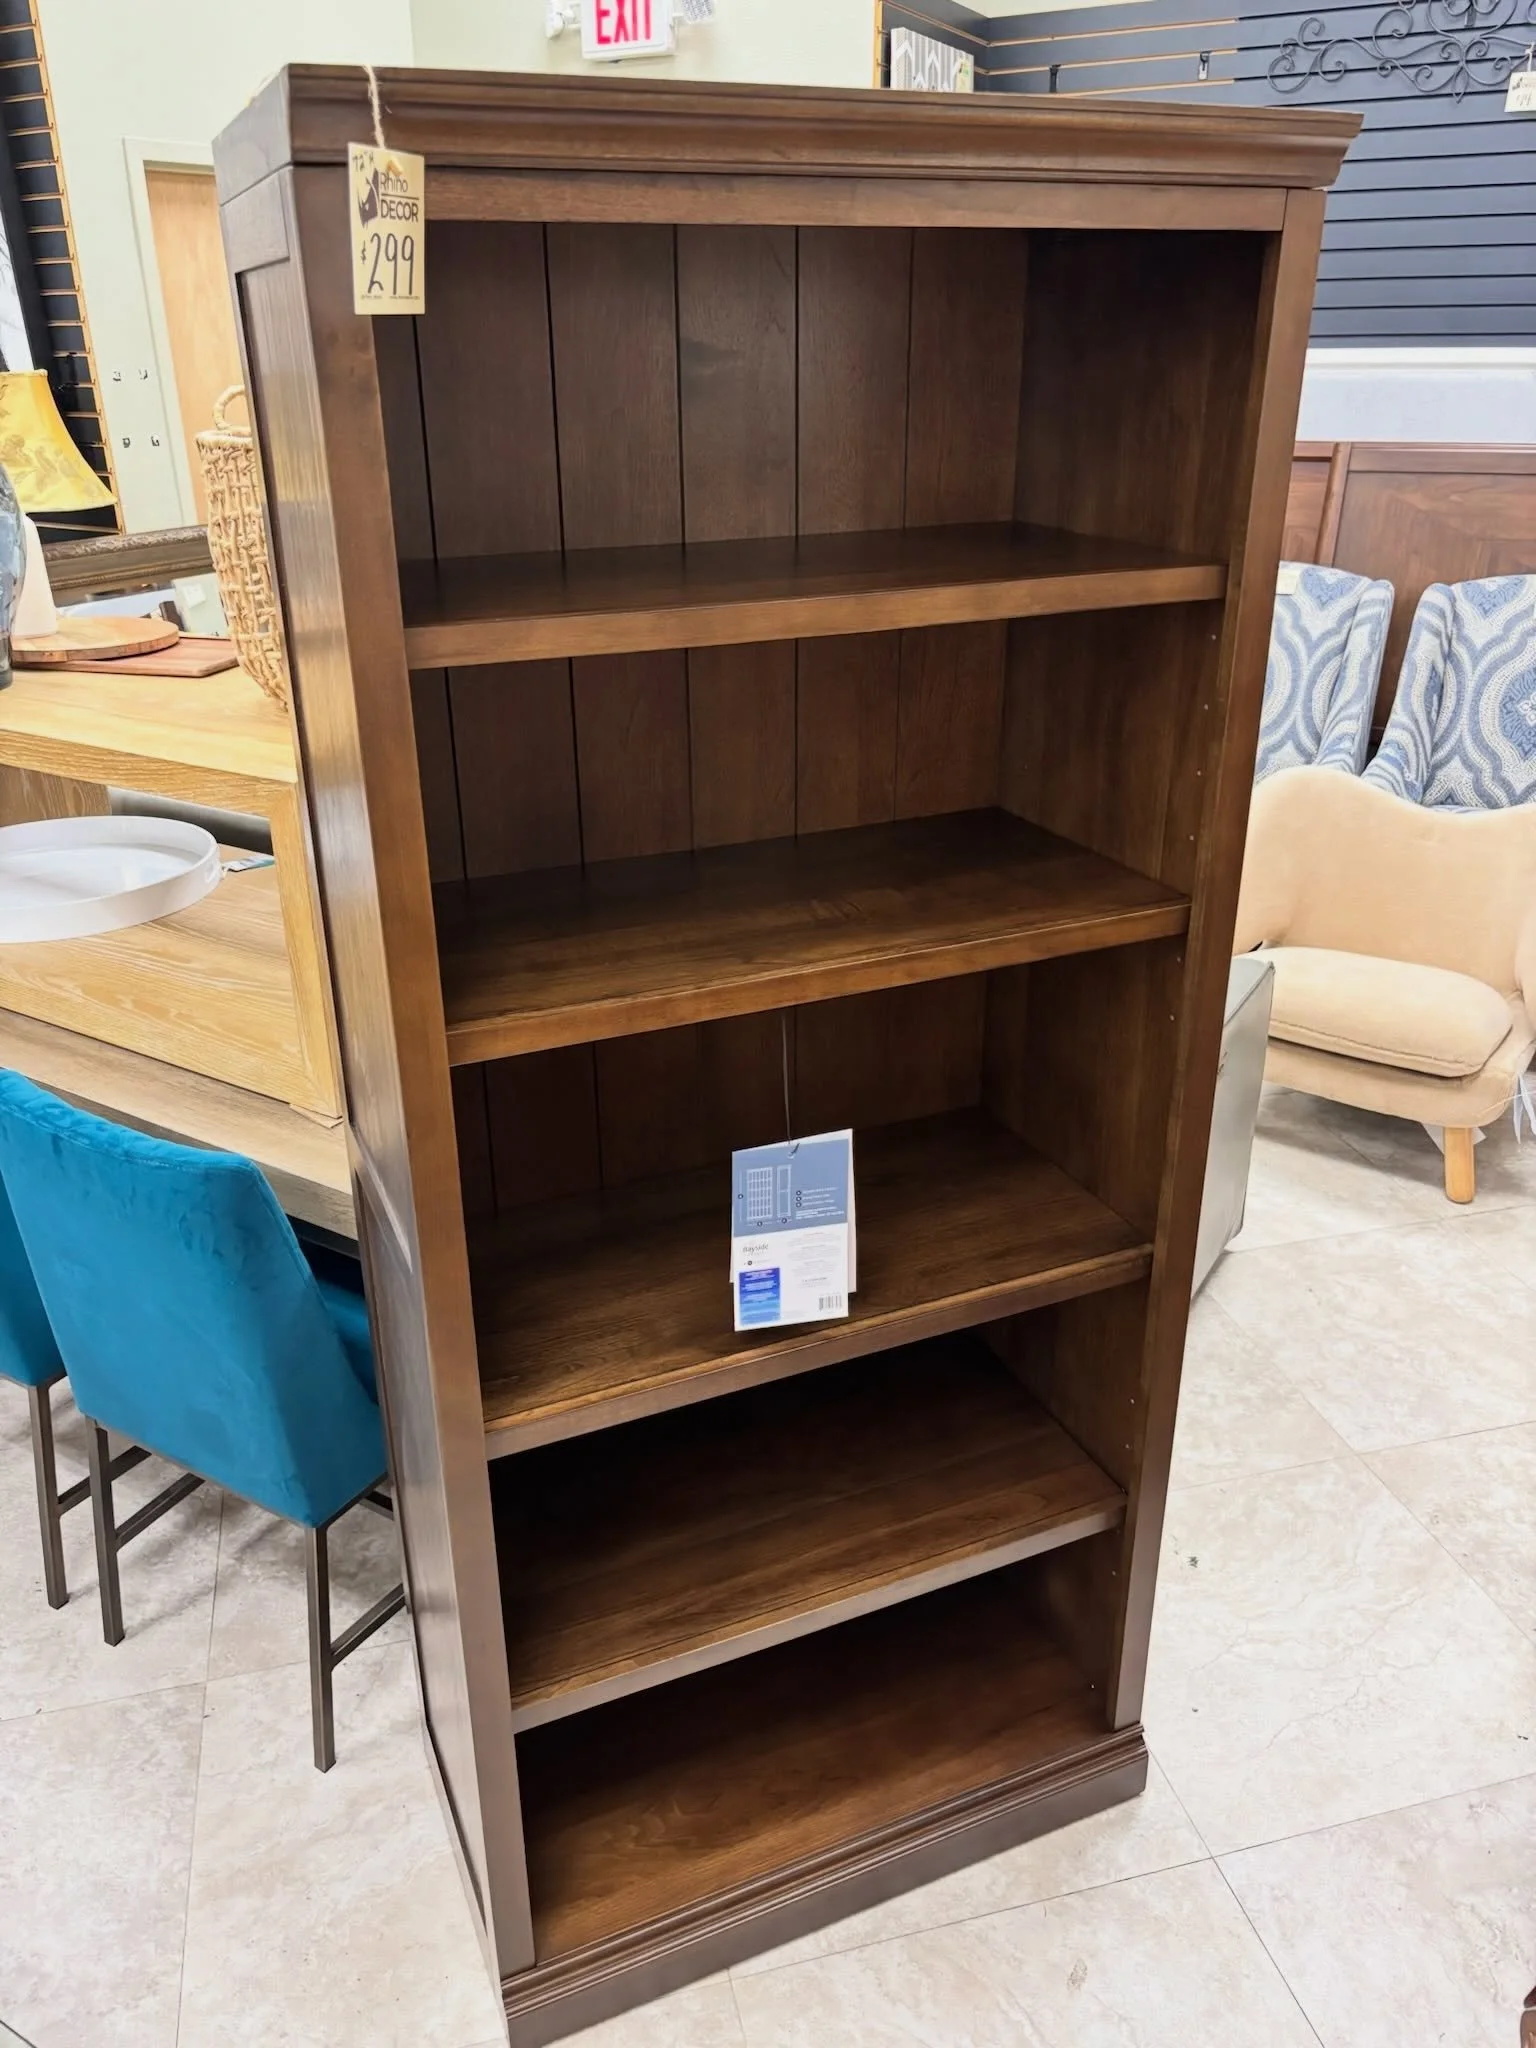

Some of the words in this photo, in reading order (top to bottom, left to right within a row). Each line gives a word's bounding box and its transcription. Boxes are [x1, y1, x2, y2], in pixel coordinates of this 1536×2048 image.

[380, 170, 408, 193] Rhino
[381, 199, 419, 222] DECOR
[360, 232, 415, 296] $299
